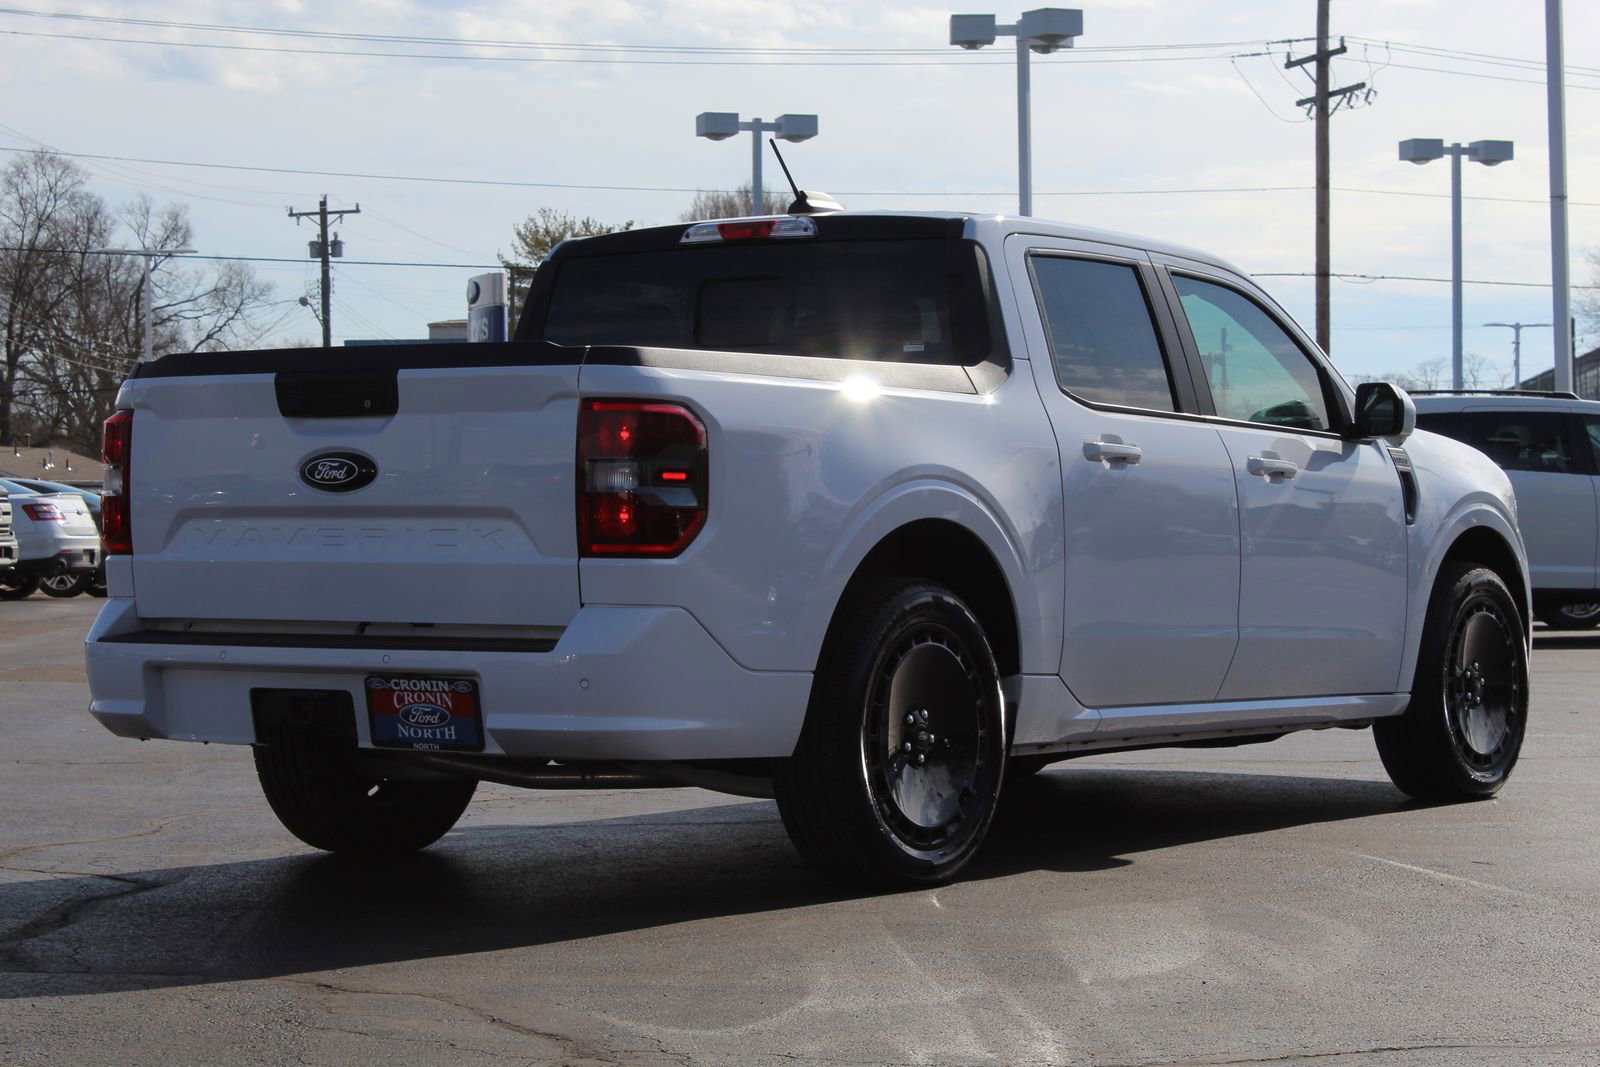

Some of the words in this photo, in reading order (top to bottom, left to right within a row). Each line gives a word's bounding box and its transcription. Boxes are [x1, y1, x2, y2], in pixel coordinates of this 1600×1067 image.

[314, 461, 348, 479] Ford
[390, 679, 449, 692] CRONIN
[393, 691, 453, 710] CRONIN
[409, 706, 440, 723] Ford
[397, 723, 456, 740] NORTH
[413, 742, 440, 751] NORTH
